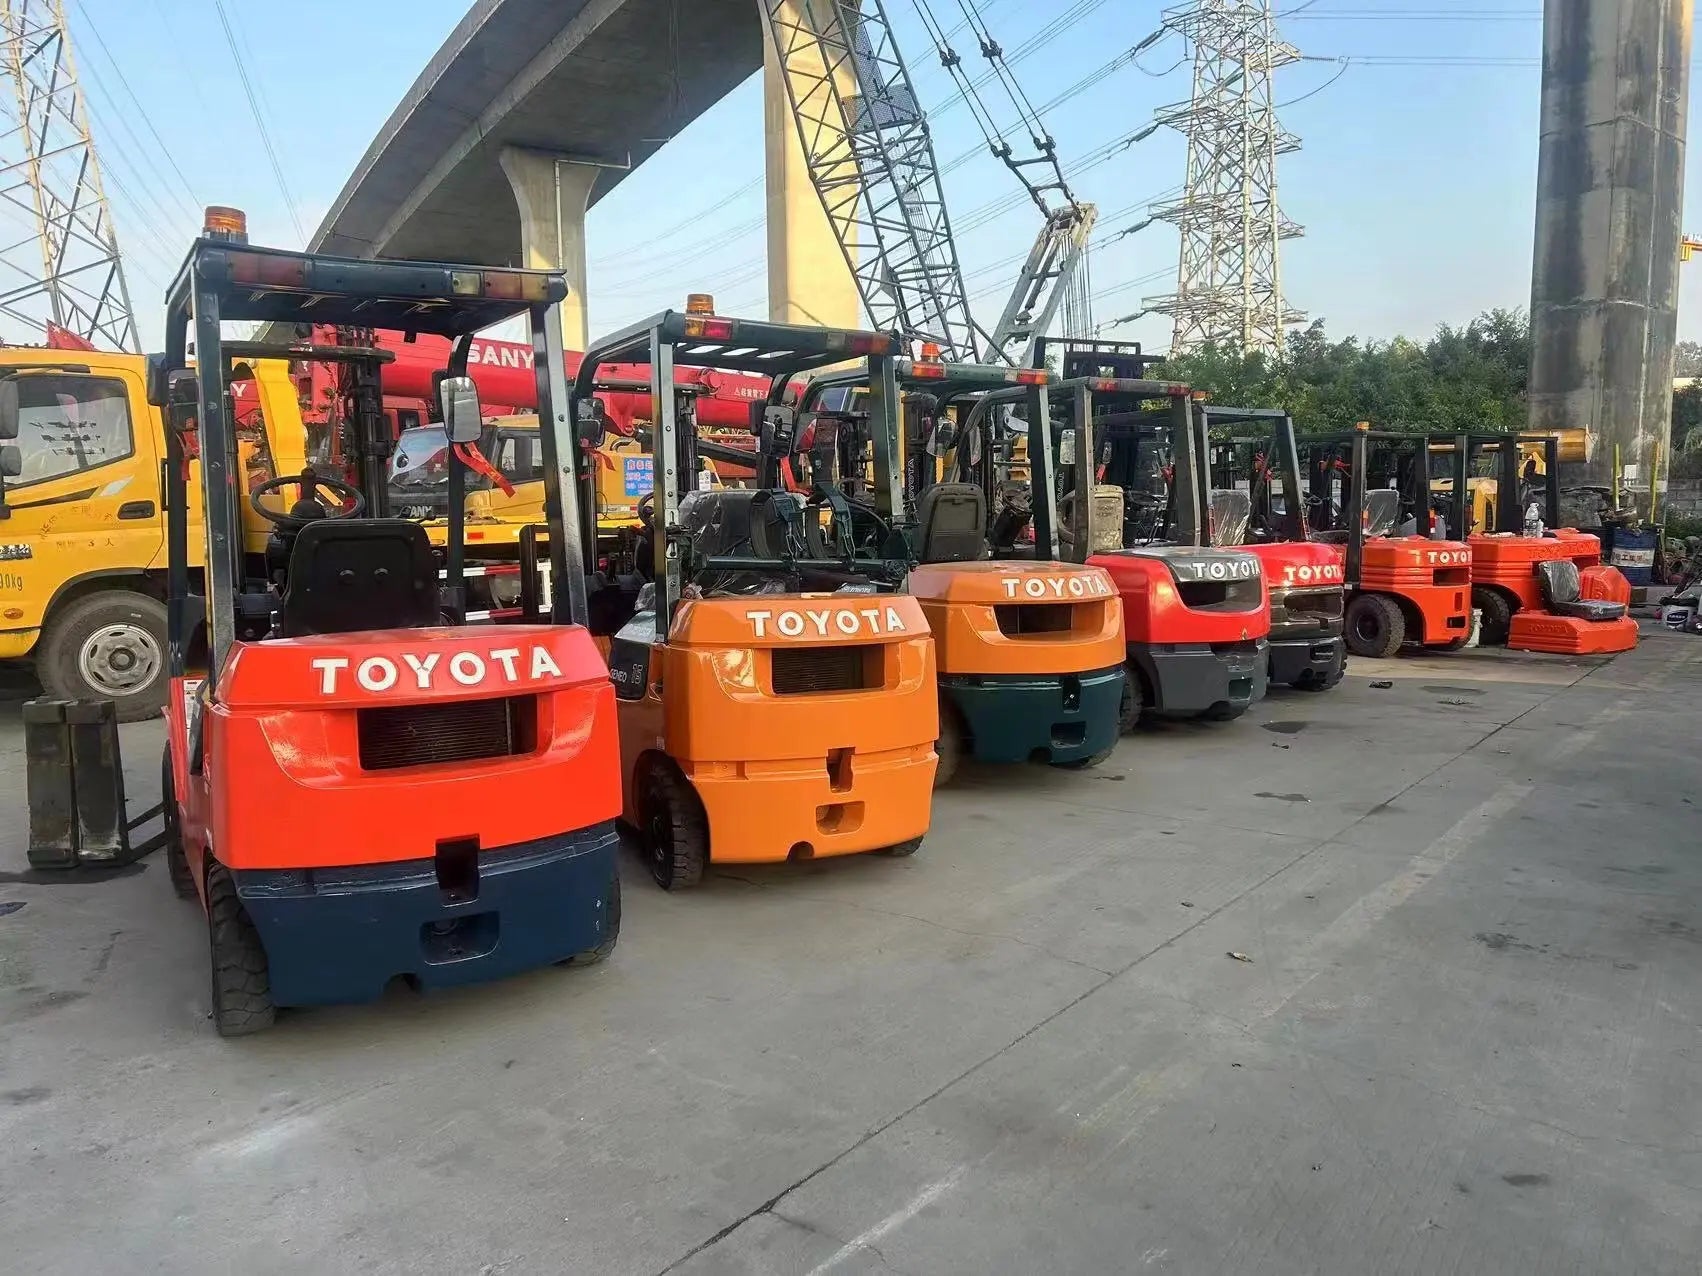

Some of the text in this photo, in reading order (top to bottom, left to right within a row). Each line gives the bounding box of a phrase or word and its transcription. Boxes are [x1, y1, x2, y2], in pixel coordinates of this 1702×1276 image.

[467, 343, 536, 369] SANY
[1193, 559, 1260, 579] TOYOTA
[1284, 565, 1341, 581] TOYOTA
[1001, 575, 1108, 598] TOYOTA
[746, 607, 906, 637] TOYOTA
[311, 646, 562, 694] TOYOTA
